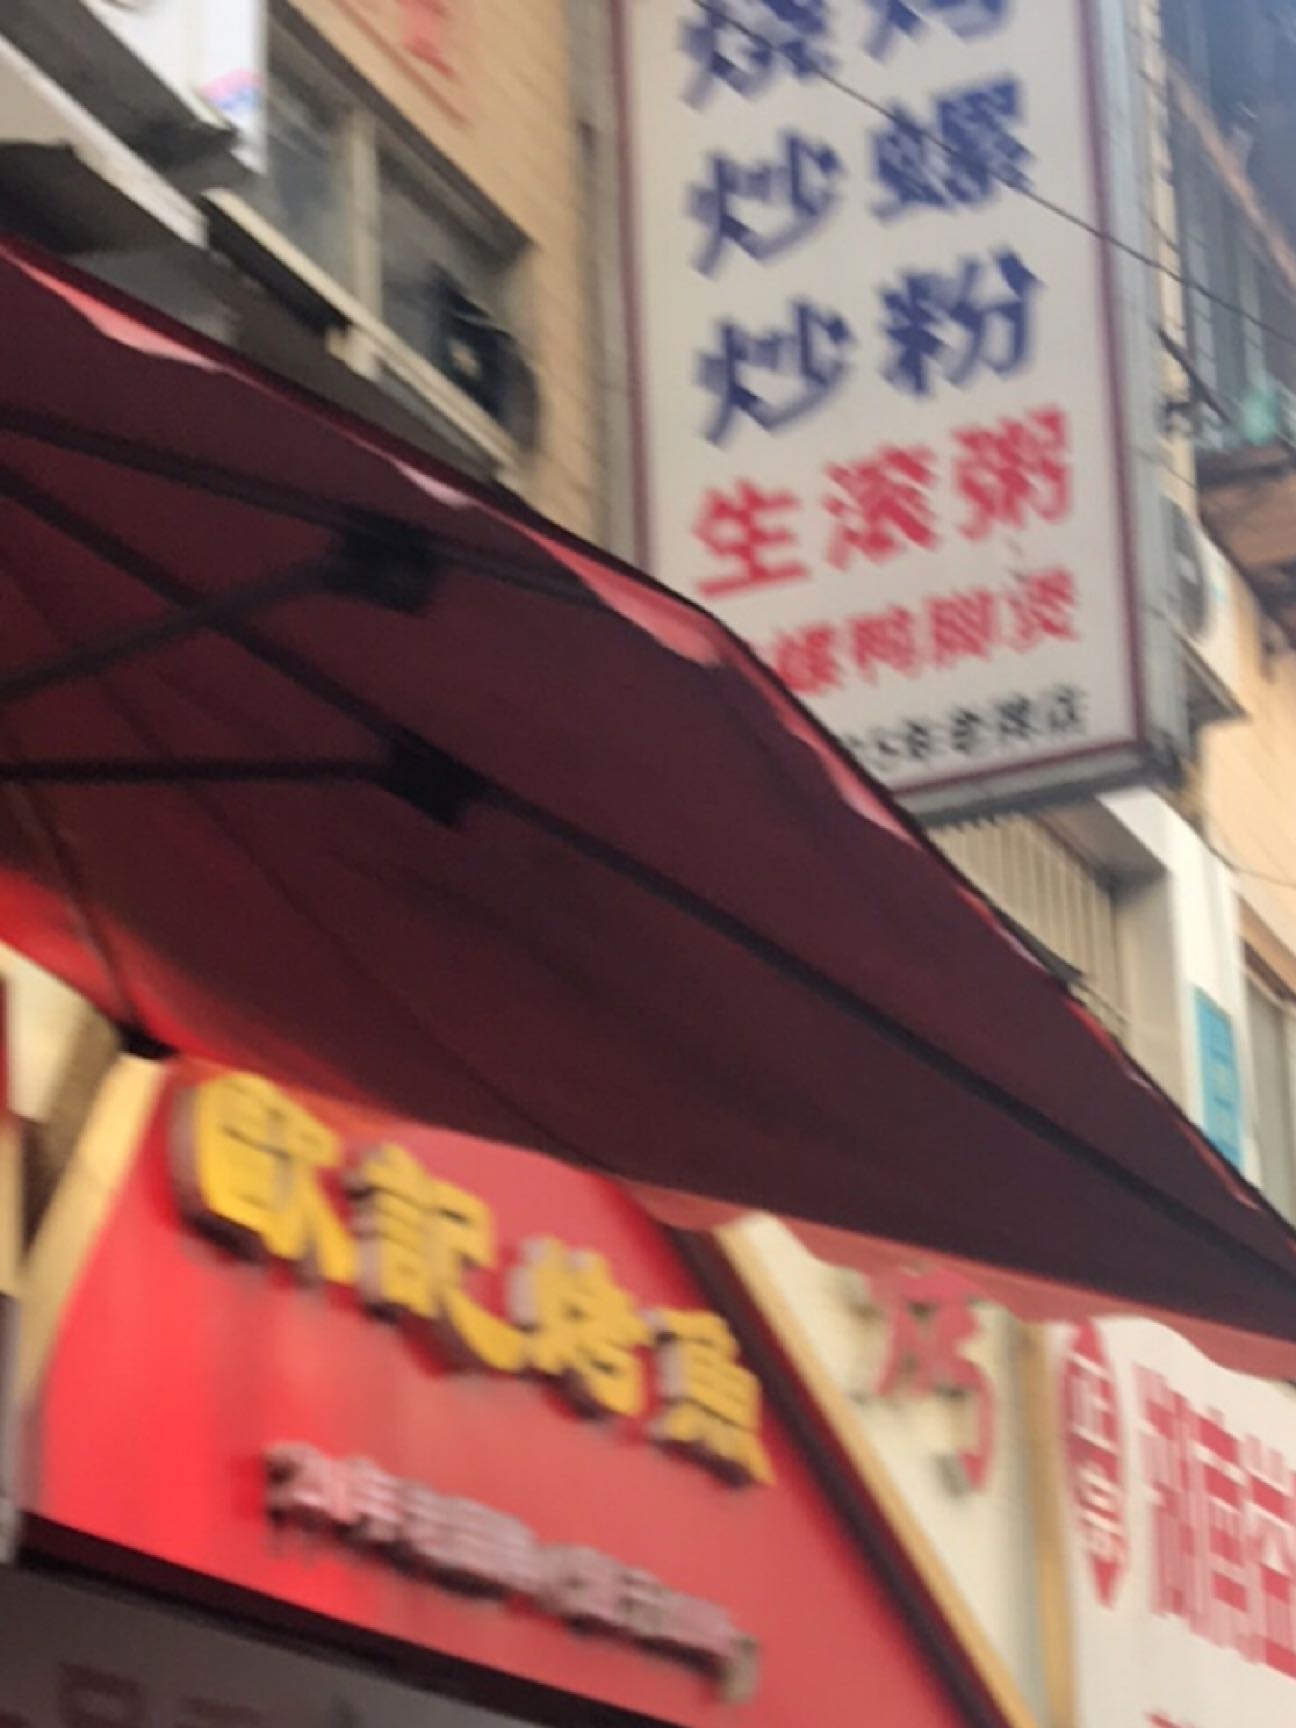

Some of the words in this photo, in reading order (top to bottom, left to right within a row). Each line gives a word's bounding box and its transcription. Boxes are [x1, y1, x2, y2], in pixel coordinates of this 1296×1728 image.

[690, 244, 1048, 450] 炒粉
[690, 403, 1073, 598] 生滚粥
